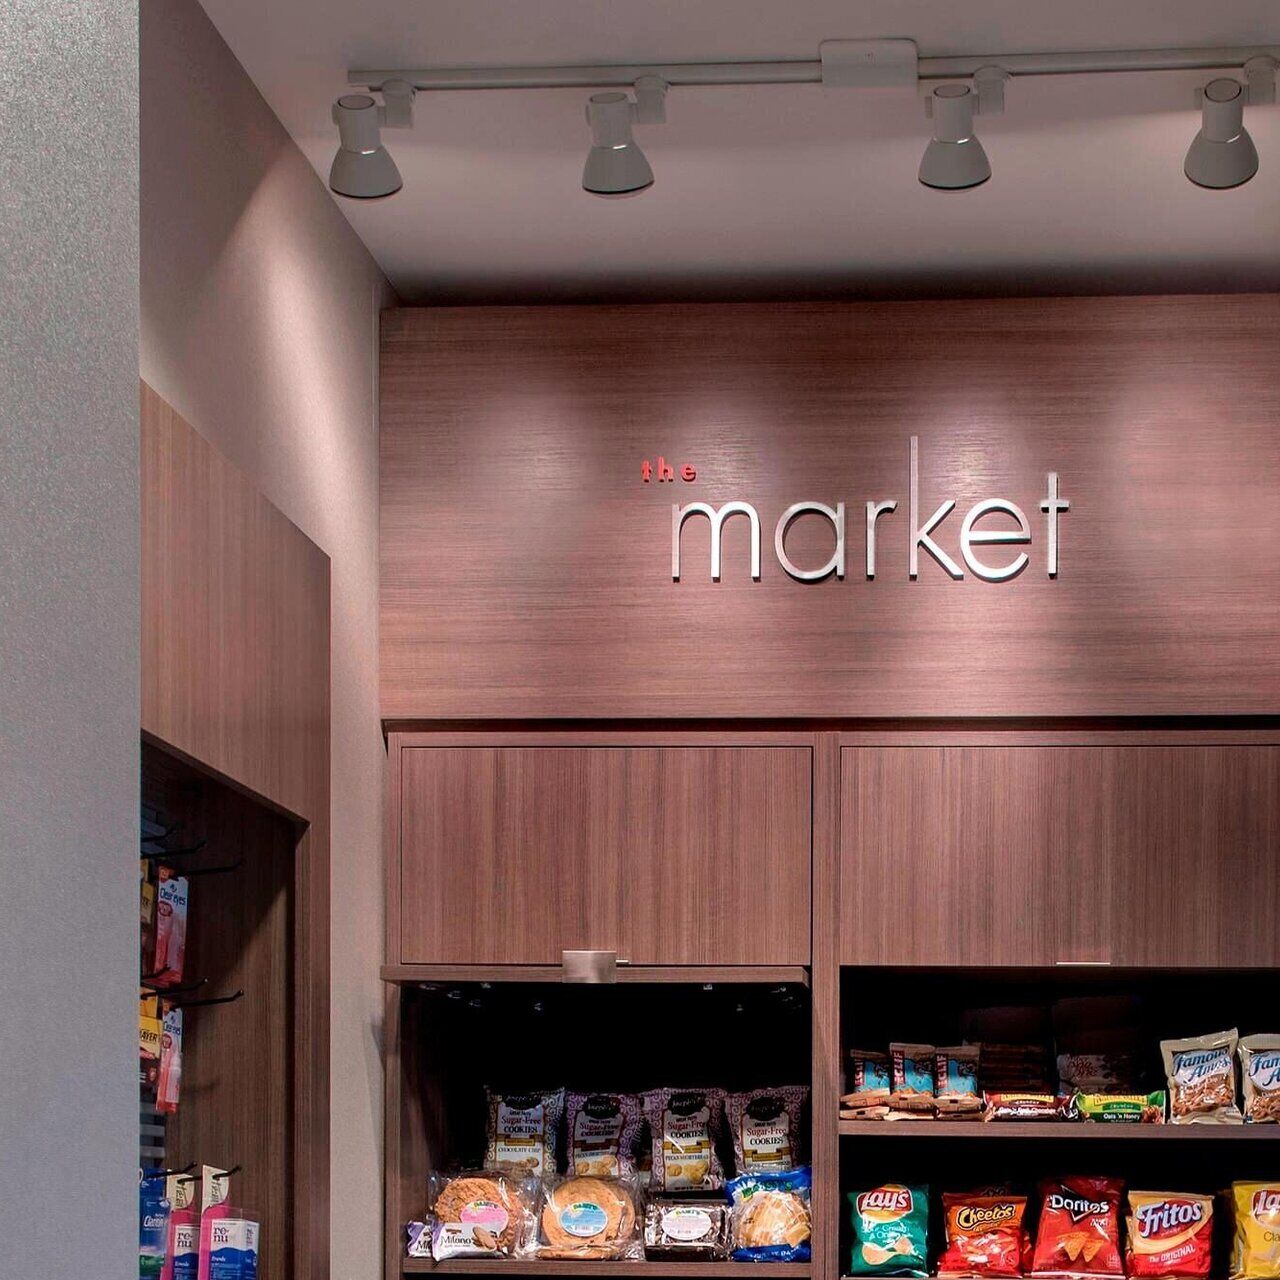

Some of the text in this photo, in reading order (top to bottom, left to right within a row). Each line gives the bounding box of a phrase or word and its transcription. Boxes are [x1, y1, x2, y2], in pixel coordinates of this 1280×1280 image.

[640, 457, 697, 483] the
[671, 435, 1070, 584] market
[1173, 1047, 1229, 1077] Famous
[1188, 1056, 1232, 1082] Amos
[504, 1125, 538, 1134] COOKIES
[670, 1130, 704, 1139] COOKIES
[746, 1127, 787, 1137] Sugar-Free
[750, 1136, 784, 1146] COOKIES
[862, 1189, 908, 1211] Lay's
[1050, 1194, 1110, 1214] Doritos
[958, 1204, 1016, 1231] Cheetos
[1136, 1201, 1204, 1238] Fritos
[213, 1235, 228, 1243] nu
[1160, 1245, 1196, 1262] ORIGINAL
